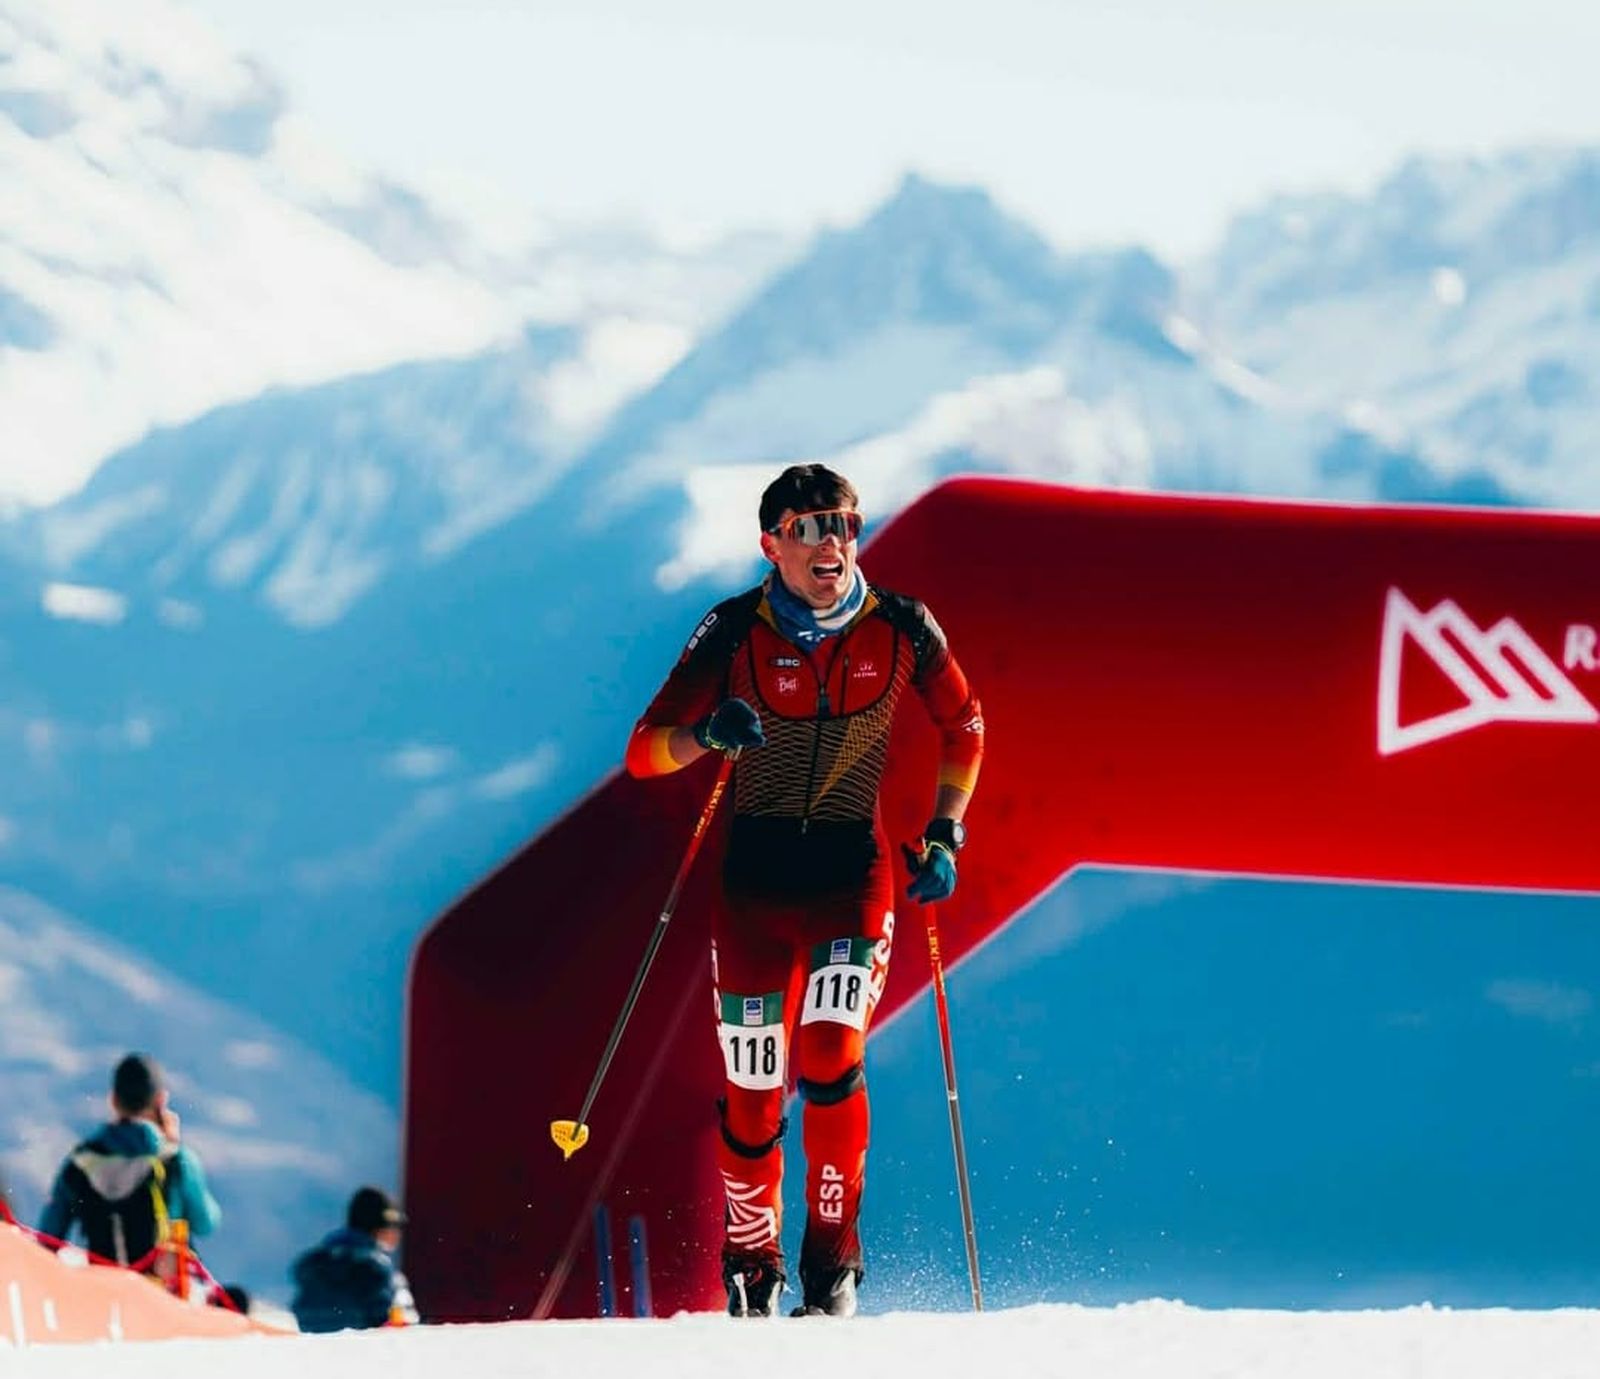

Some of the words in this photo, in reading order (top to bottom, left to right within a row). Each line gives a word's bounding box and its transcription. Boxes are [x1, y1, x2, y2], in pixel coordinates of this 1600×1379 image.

[1564, 623, 1600, 670] R
[927, 926, 941, 960] LEKI
[815, 972, 862, 1013] 118
[729, 1035, 777, 1076] 118
[818, 1163, 845, 1219] ESP
